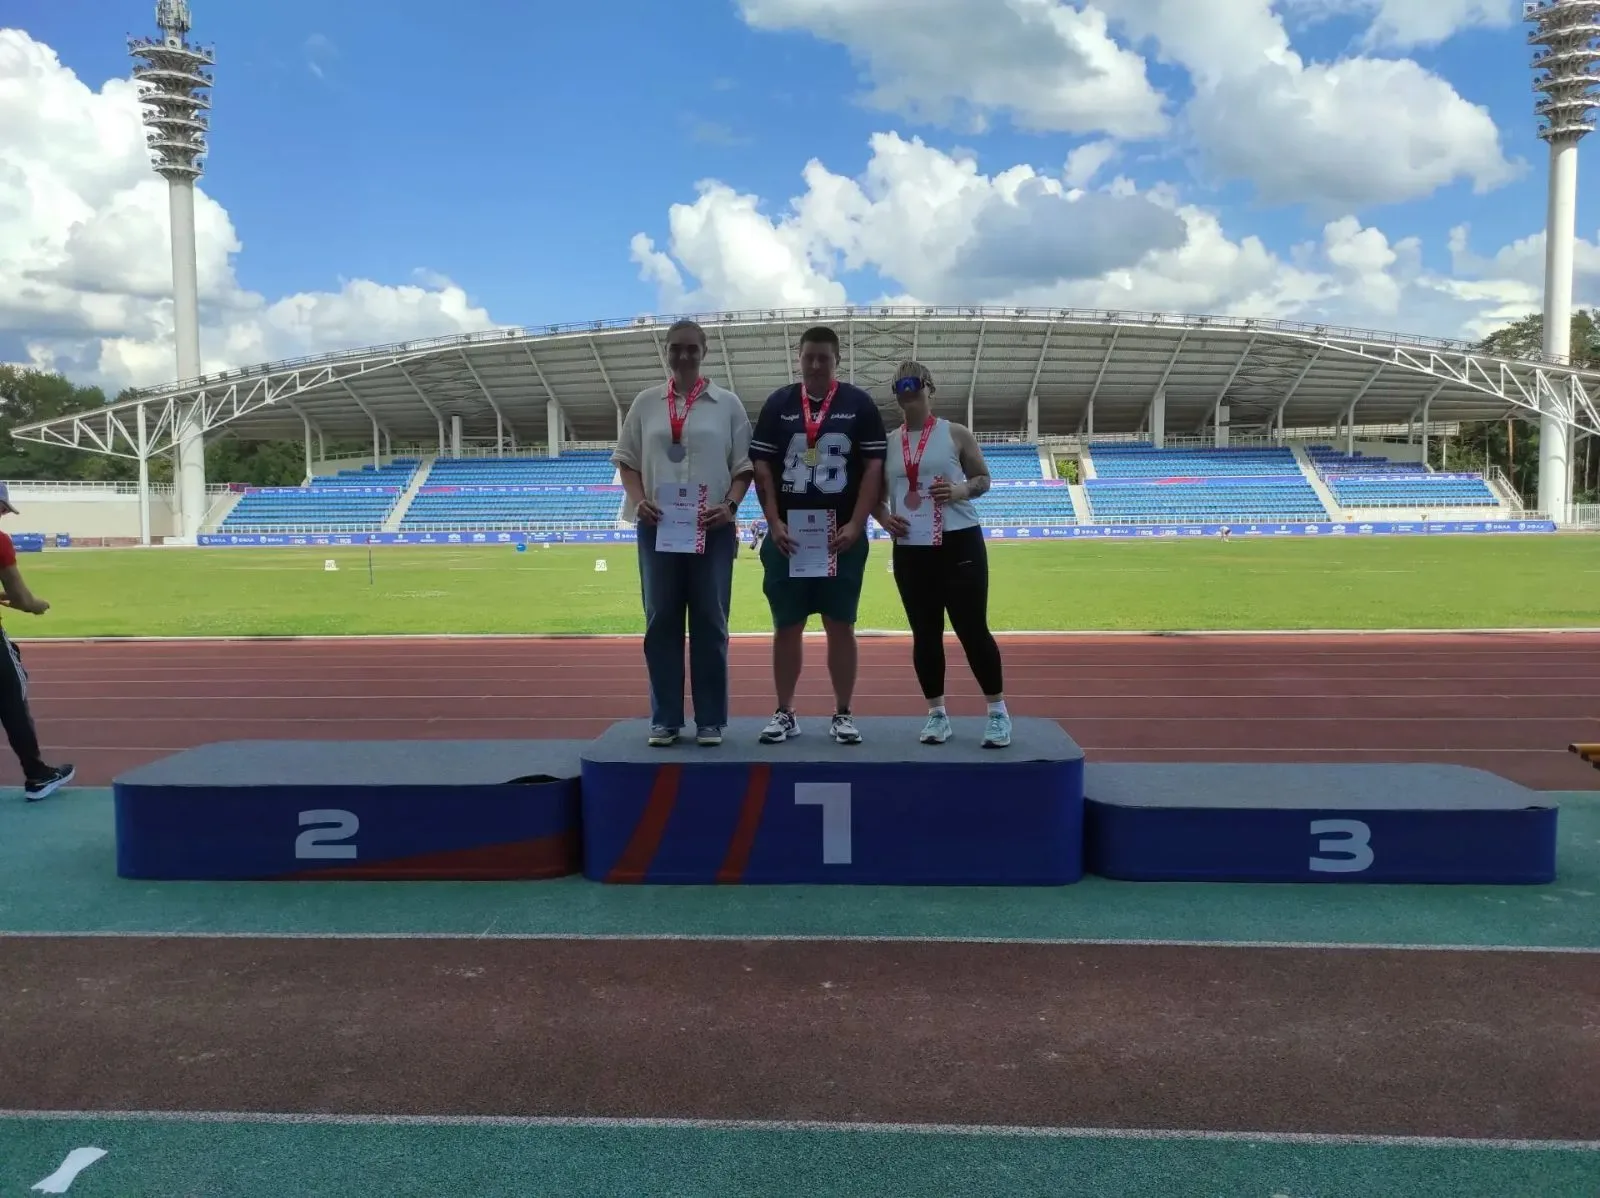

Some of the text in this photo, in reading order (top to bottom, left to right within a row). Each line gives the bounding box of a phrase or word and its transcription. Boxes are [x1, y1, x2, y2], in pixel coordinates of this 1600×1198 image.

[782, 432, 852, 494] 46
[295, 808, 360, 859] 2
[794, 782, 852, 865] 1
[1309, 819, 1375, 873] 3
